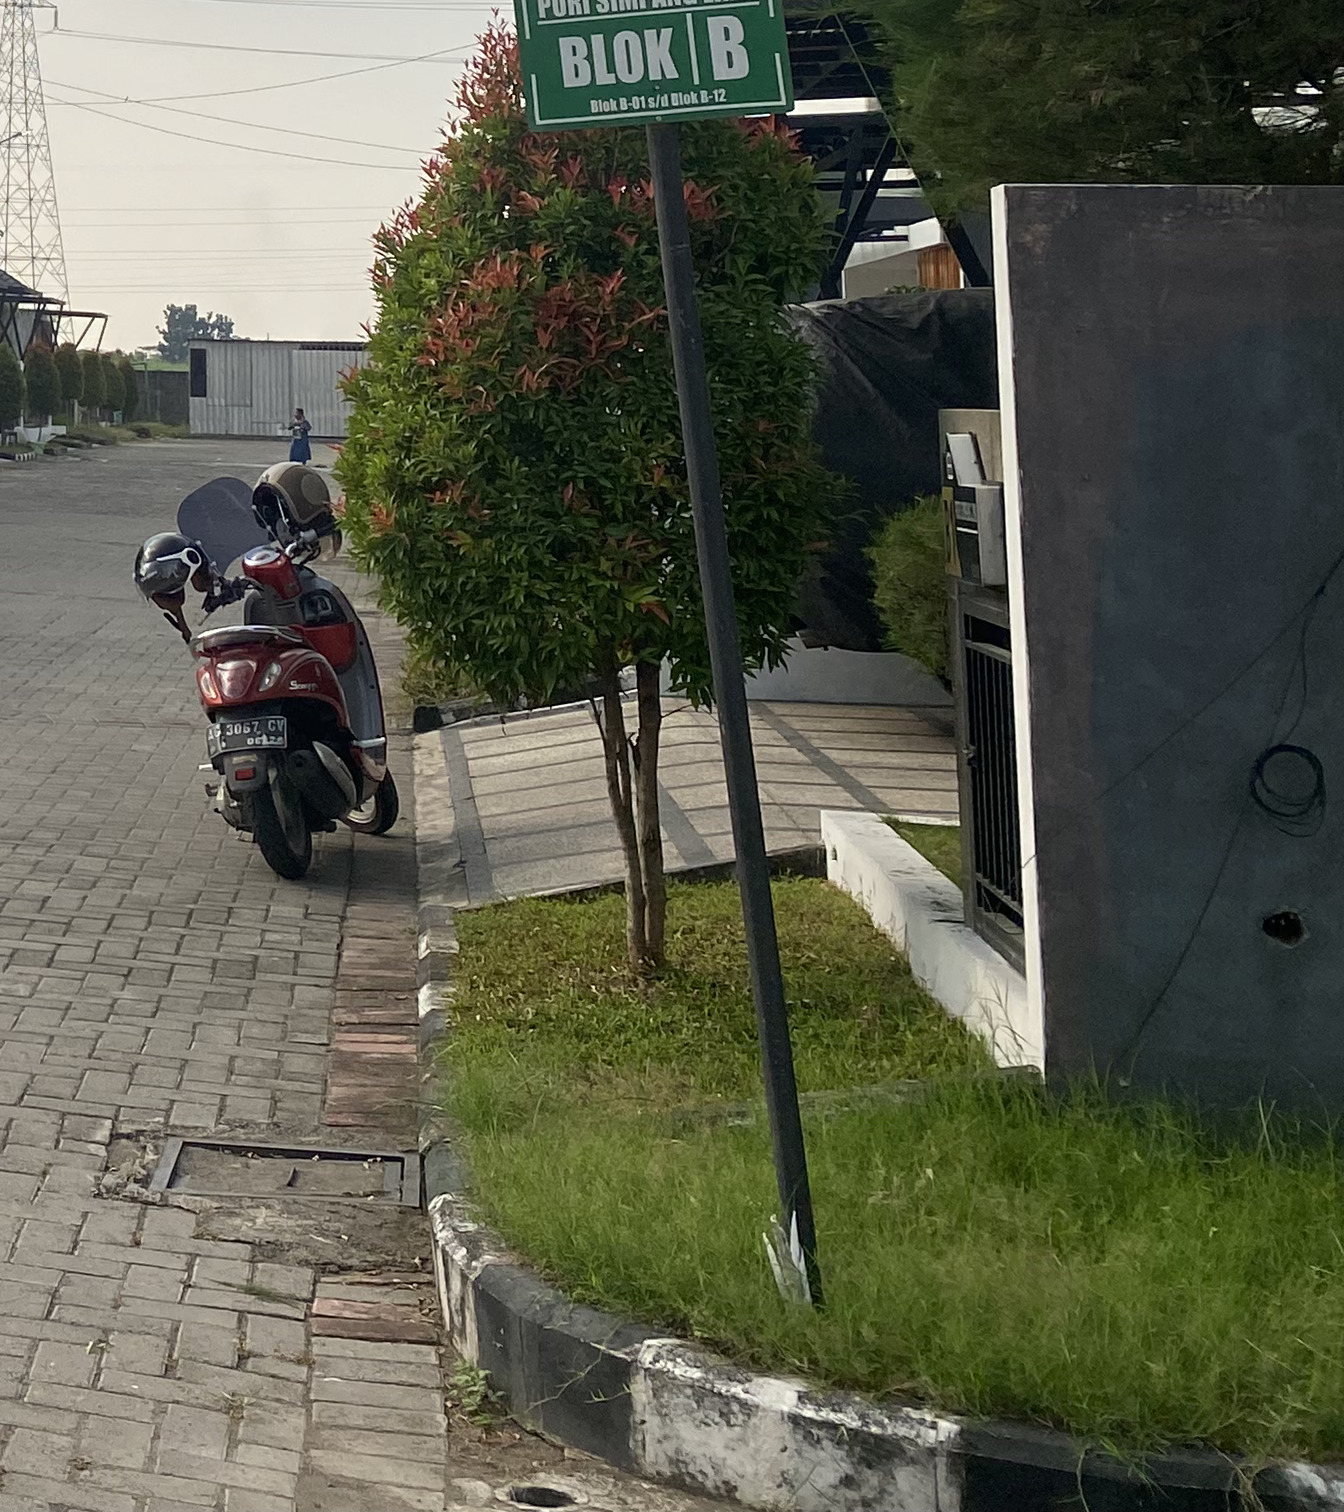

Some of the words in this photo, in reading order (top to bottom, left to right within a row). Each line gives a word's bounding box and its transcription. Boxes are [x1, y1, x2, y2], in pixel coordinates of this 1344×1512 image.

[559, 27, 680, 88] BLOK
[706, 15, 750, 81] B
[590, 98, 618, 113] Blok
[619, 95, 646, 110] B-01
[648, 93, 669, 108] s/d
[670, 90, 699, 106] Blok
[699, 88, 727, 103] B-12
[226, 720, 260, 736] 3067
[267, 719, 284, 732] CV
